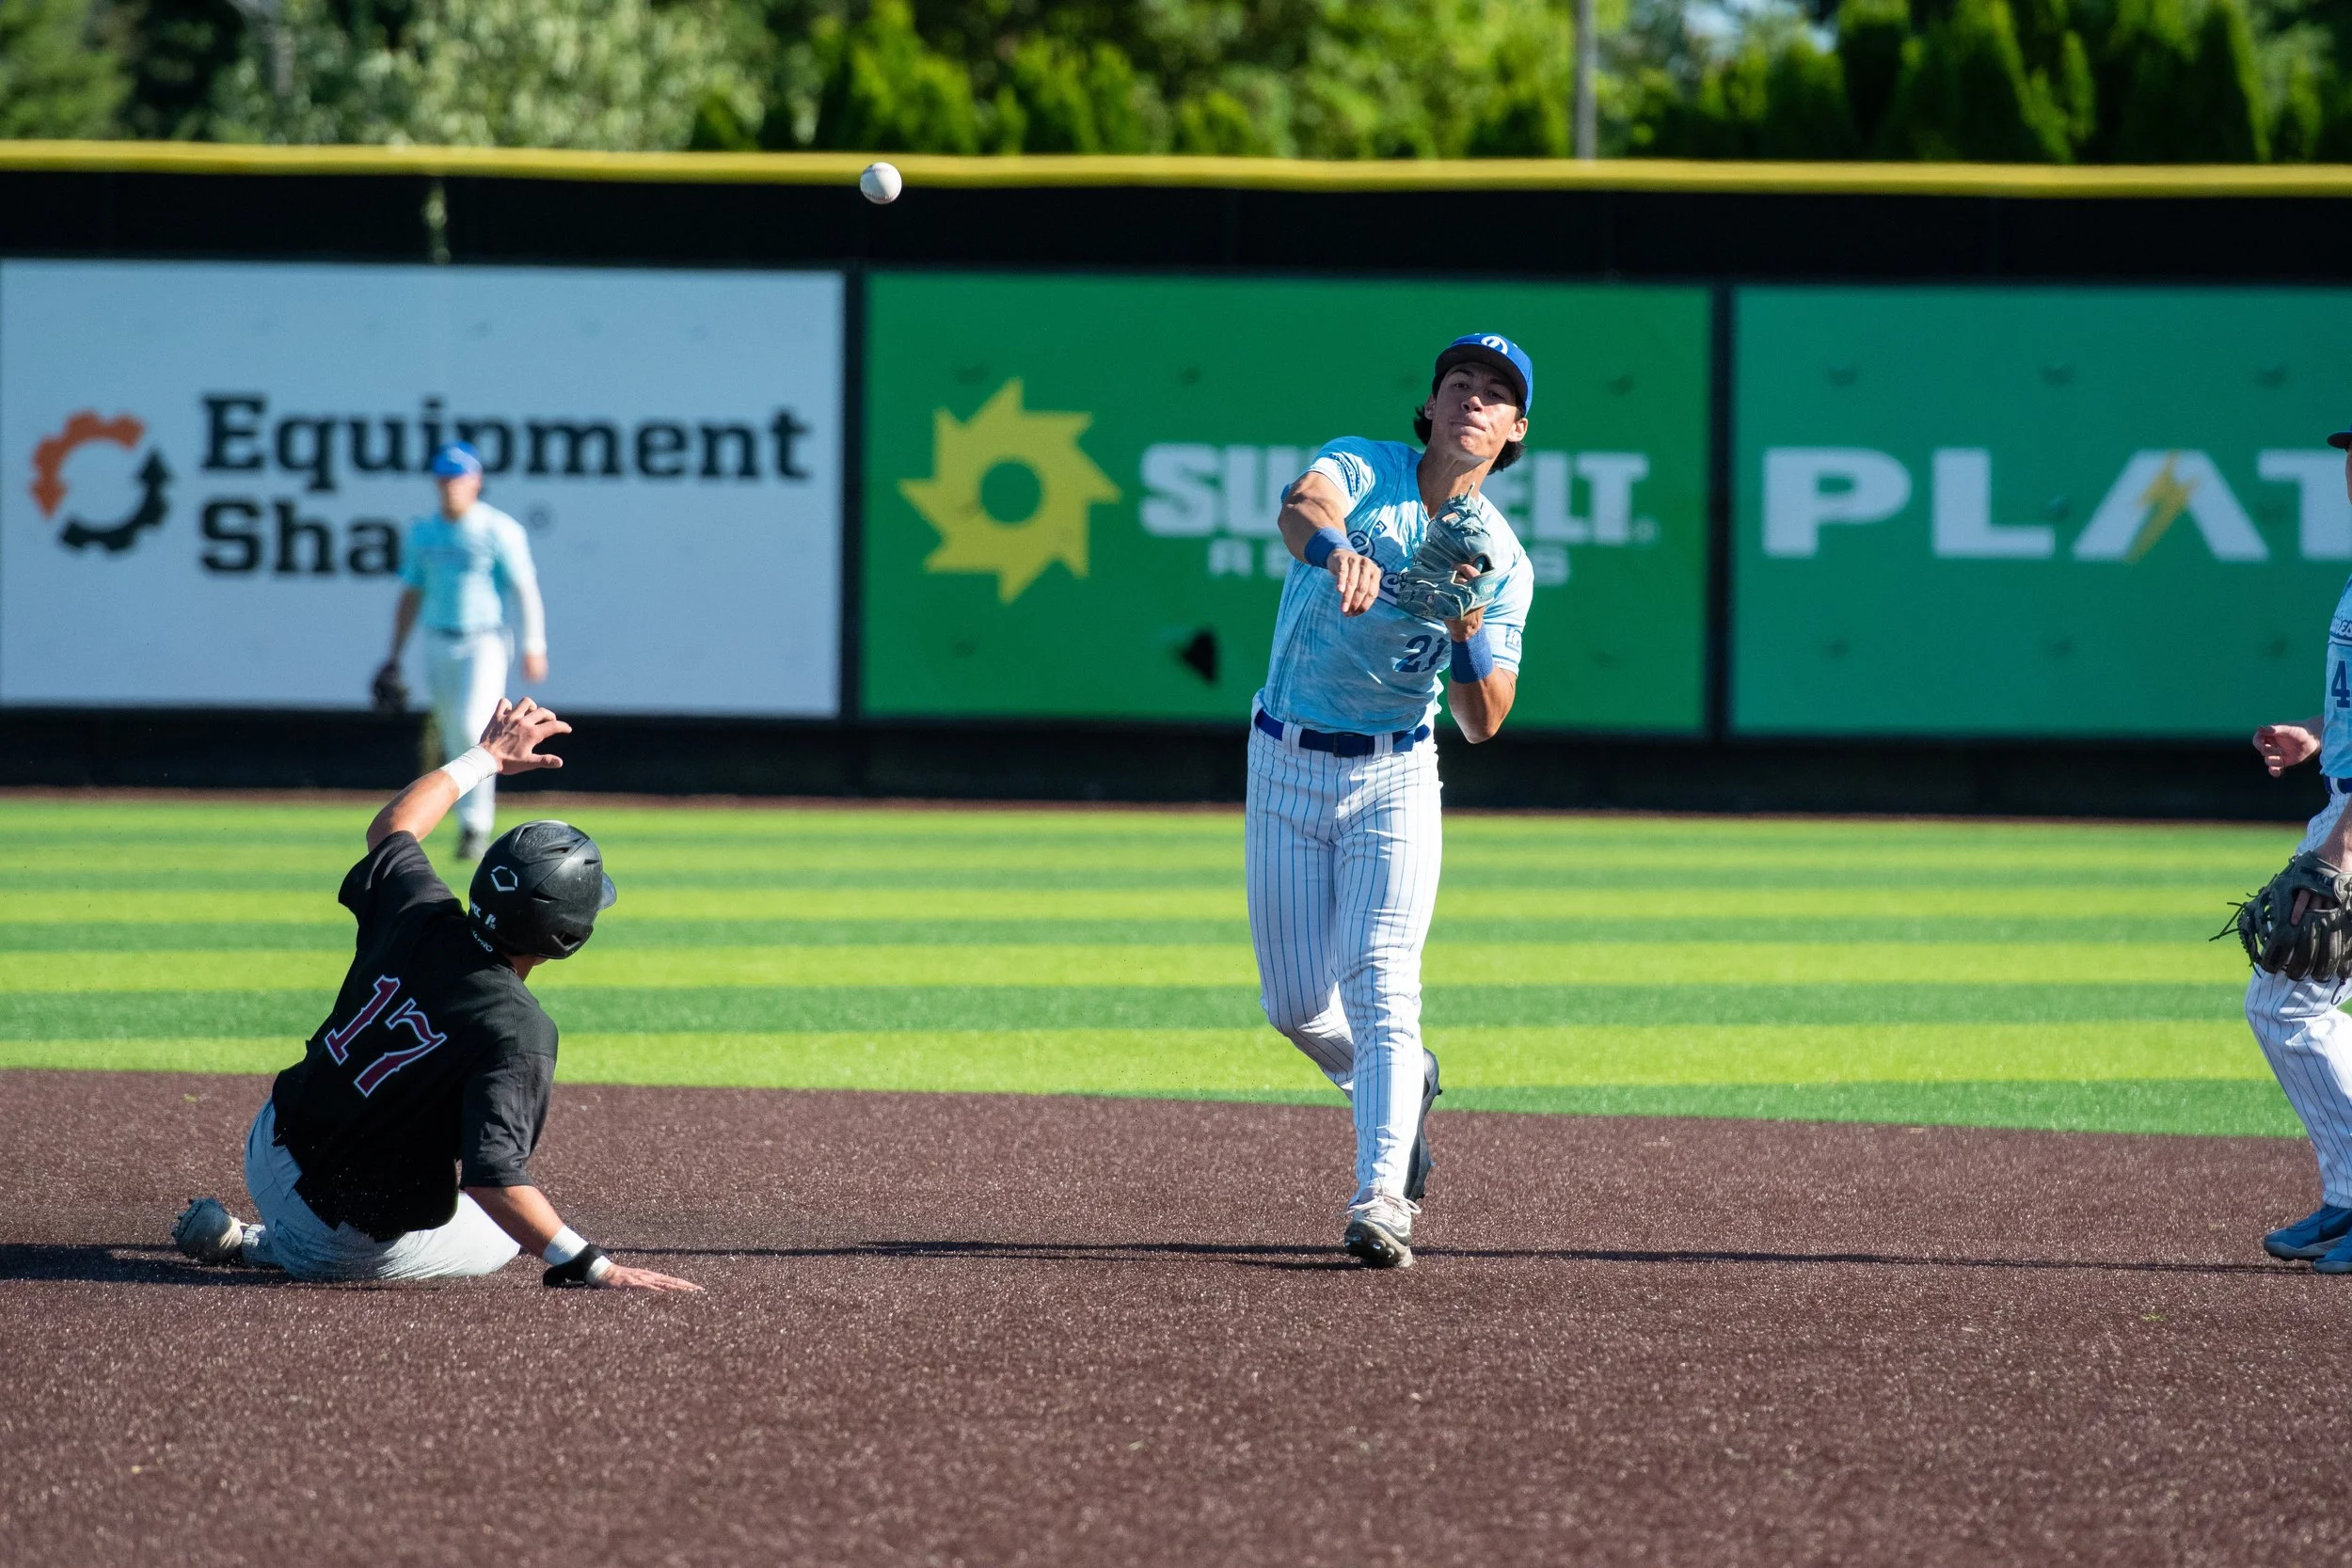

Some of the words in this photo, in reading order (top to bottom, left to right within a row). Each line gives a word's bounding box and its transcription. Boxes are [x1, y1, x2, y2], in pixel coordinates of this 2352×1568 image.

[1139, 442, 1649, 544] SUELT
[1393, 634, 1450, 673] 21
[325, 974, 448, 1099] 17
